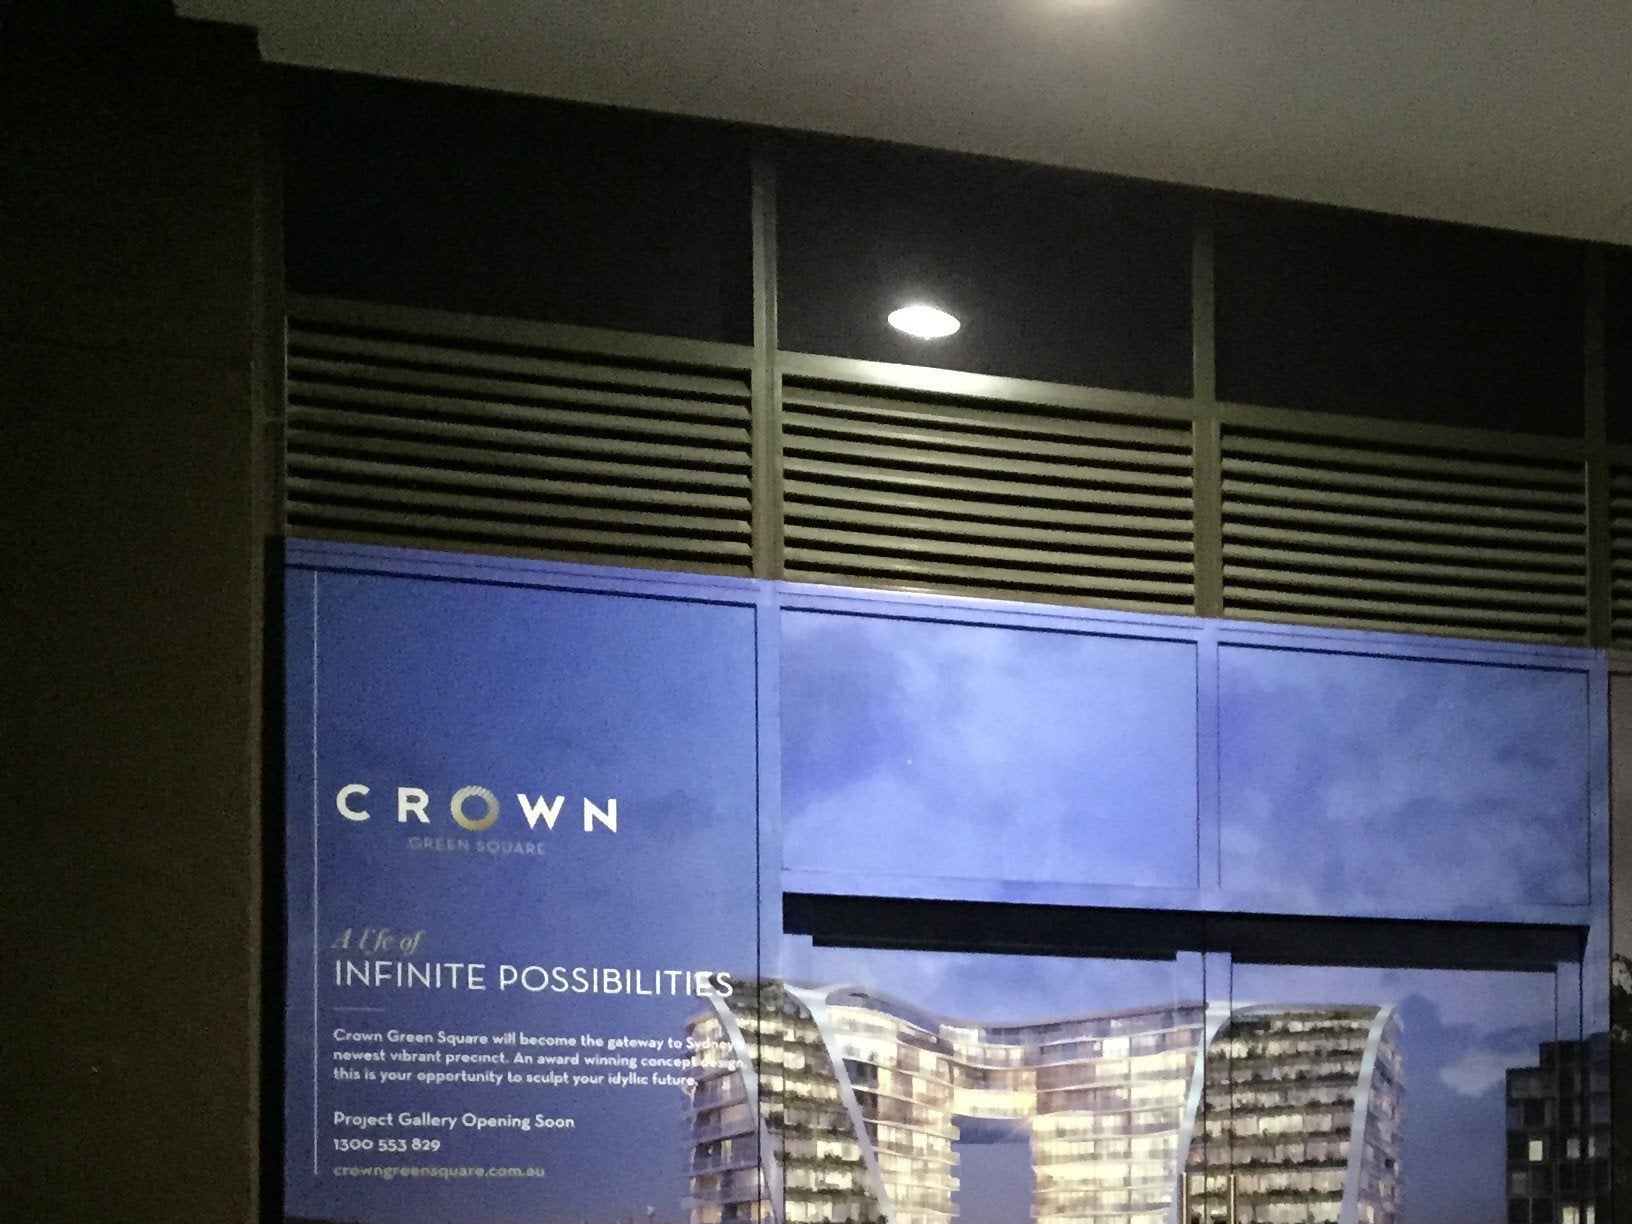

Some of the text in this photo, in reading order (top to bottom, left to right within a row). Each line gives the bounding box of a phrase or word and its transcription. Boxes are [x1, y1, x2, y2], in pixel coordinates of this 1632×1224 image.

[336, 783, 617, 833] CROWN
[408, 836, 547, 857] GREEN SQUARE
[399, 929, 427, 957] of
[335, 960, 734, 999] INFINITE POSSIBILITIES
[333, 1028, 383, 1042] Crown
[386, 1029, 433, 1043] Green
[437, 1031, 488, 1046] Square
[491, 1032, 516, 1045] will
[519, 1032, 577, 1047] become
[580, 1034, 604, 1047] the
[607, 1036, 664, 1050] gateway
[667, 1037, 682, 1049] to
[333, 1049, 386, 1061] newest
[389, 1049, 441, 1062] vibrant
[513, 1053, 533, 1064] An
[537, 1053, 579, 1065] award
[583, 1054, 637, 1069] winning
[640, 1056, 697, 1070] concept
[333, 1067, 361, 1080] this
[364, 1068, 376, 1080] is
[380, 1071, 412, 1083] your
[417, 1070, 503, 1085] opportunity
[507, 1071, 523, 1083] to
[526, 1071, 569, 1086] sculpt
[572, 1074, 604, 1086] your
[607, 1073, 648, 1087] idyllic
[333, 1111, 575, 1131] Project Gallery Opening Soon
[333, 1138, 441, 1152] 1300 553 829
[333, 1165, 546, 1180] crowngreensquare.com.au
